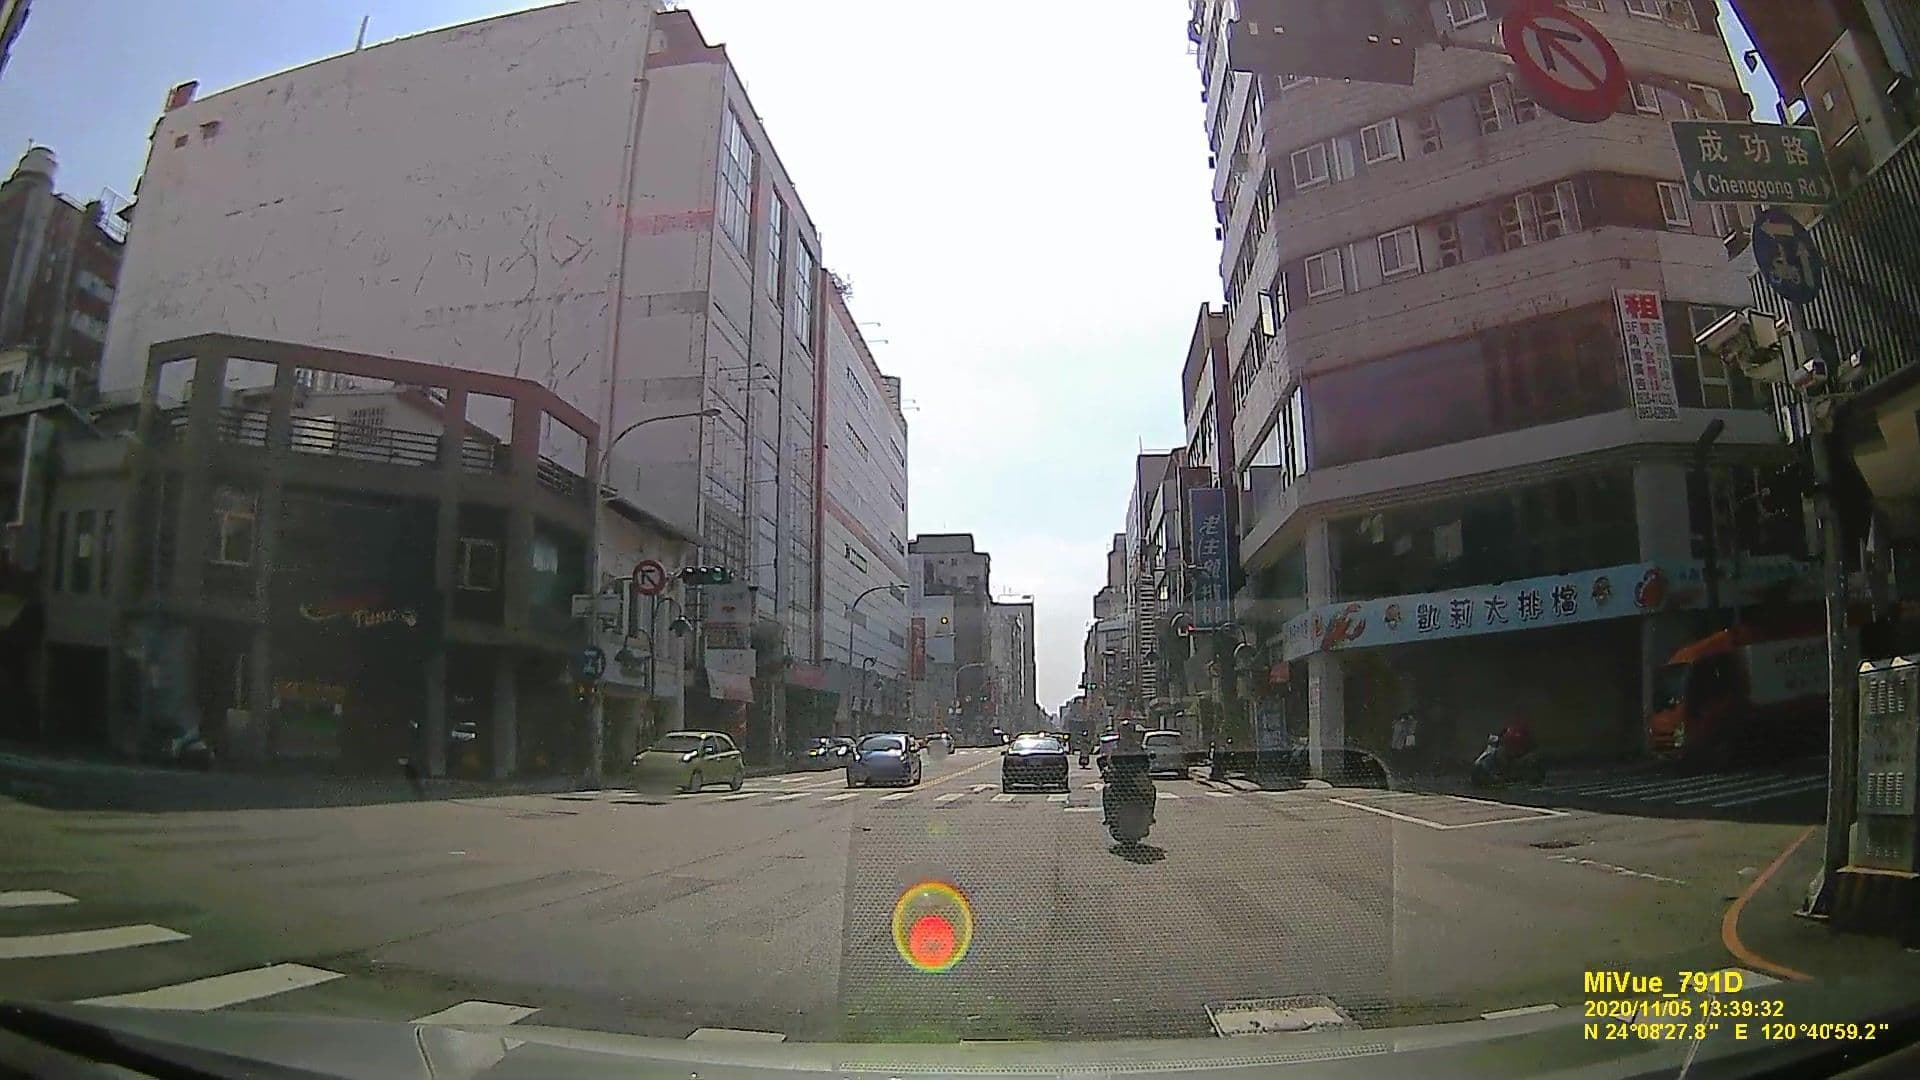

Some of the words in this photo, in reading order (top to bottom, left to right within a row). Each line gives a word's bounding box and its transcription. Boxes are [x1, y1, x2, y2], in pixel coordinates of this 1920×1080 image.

[1697, 128, 1809, 166] 成功路
[1707, 173, 1793, 199] Chenggong
[1799, 177, 1818, 197] Rd
[1623, 293, 1660, 320] 租
[1416, 583, 1578, 633] 凱莉大排檔
